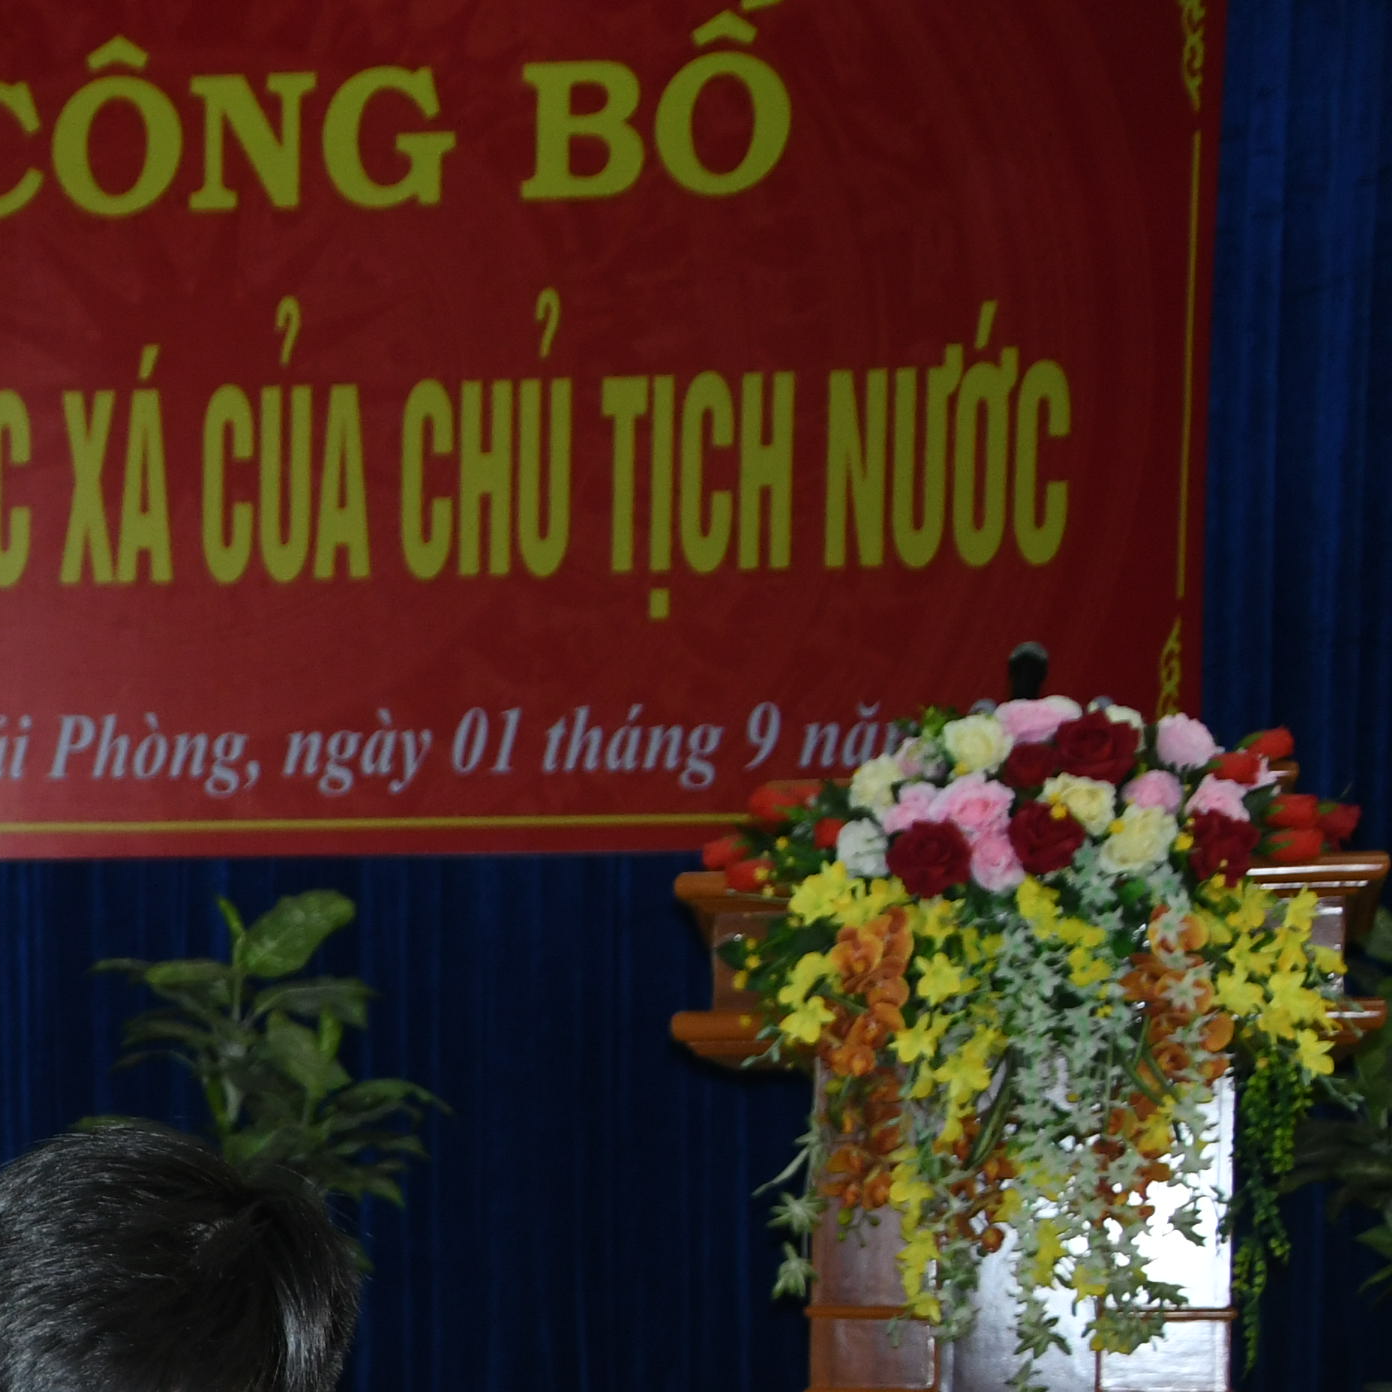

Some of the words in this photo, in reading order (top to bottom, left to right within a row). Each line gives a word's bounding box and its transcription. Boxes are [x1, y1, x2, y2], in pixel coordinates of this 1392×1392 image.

[521, 0, 792, 199] BỐ
[60, 345, 174, 584] XÁ
[202, 296, 370, 583] CỦA
[401, 288, 571, 580] CHỦ
[602, 370, 796, 620] TỊCH
[824, 300, 1070, 568] NƯỚC
[48, 711, 260, 796] Phòng,
[282, 708, 433, 795] ngày
[452, 707, 520, 774] 01
[542, 704, 724, 790] tháng
[744, 701, 781, 771] 9
[798, 701, 910, 768] nă
